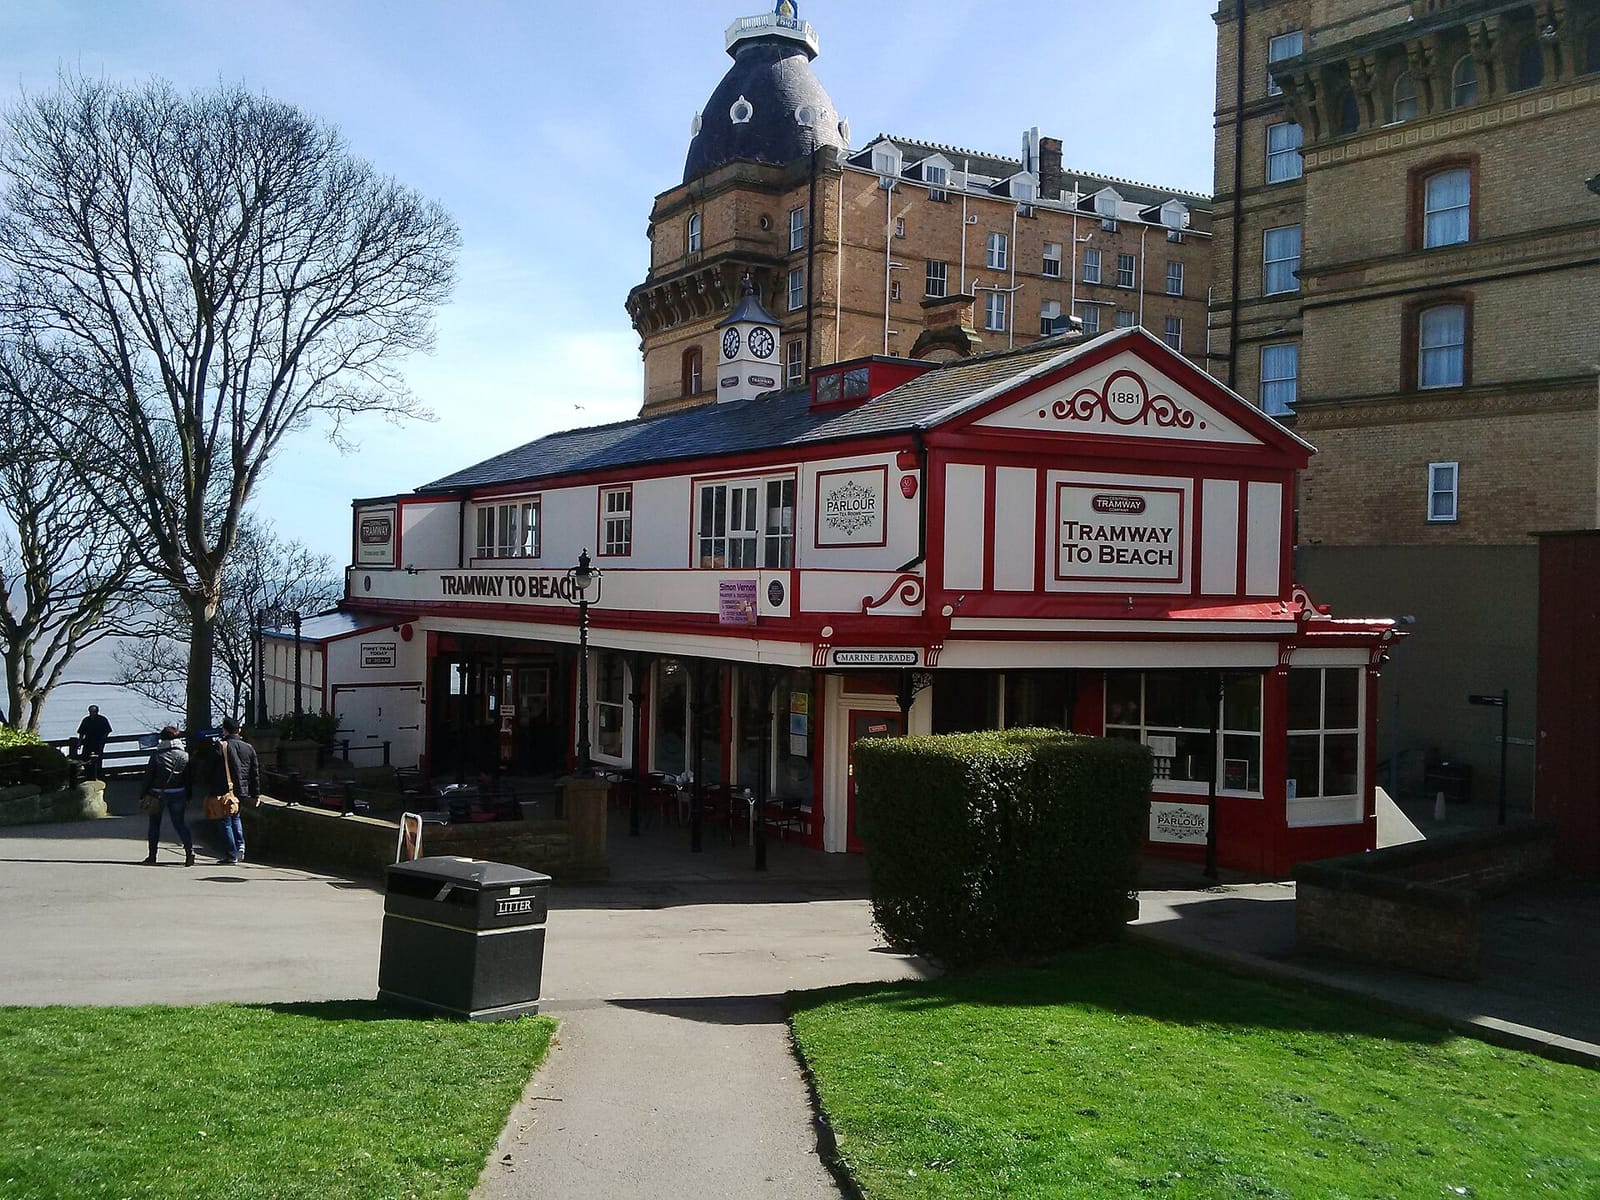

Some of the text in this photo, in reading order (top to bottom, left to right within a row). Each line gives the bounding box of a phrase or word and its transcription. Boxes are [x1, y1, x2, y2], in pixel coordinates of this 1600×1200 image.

[1112, 392, 1139, 404] 1881
[827, 498, 875, 512] PARLOUR
[1096, 499, 1141, 509] TRAMWAY
[362, 526, 389, 537] TRAMWAY
[1063, 521, 1173, 543] TRAMWAY
[1062, 543, 1173, 565] TO BEACH
[440, 575, 584, 601] TRAMWAY TO BEACH
[720, 583, 756, 591] Simon Vernon
[841, 654, 911, 662] MARINE PARADE
[1158, 817, 1205, 827] PARLOUR
[499, 900, 532, 912] LITTER
